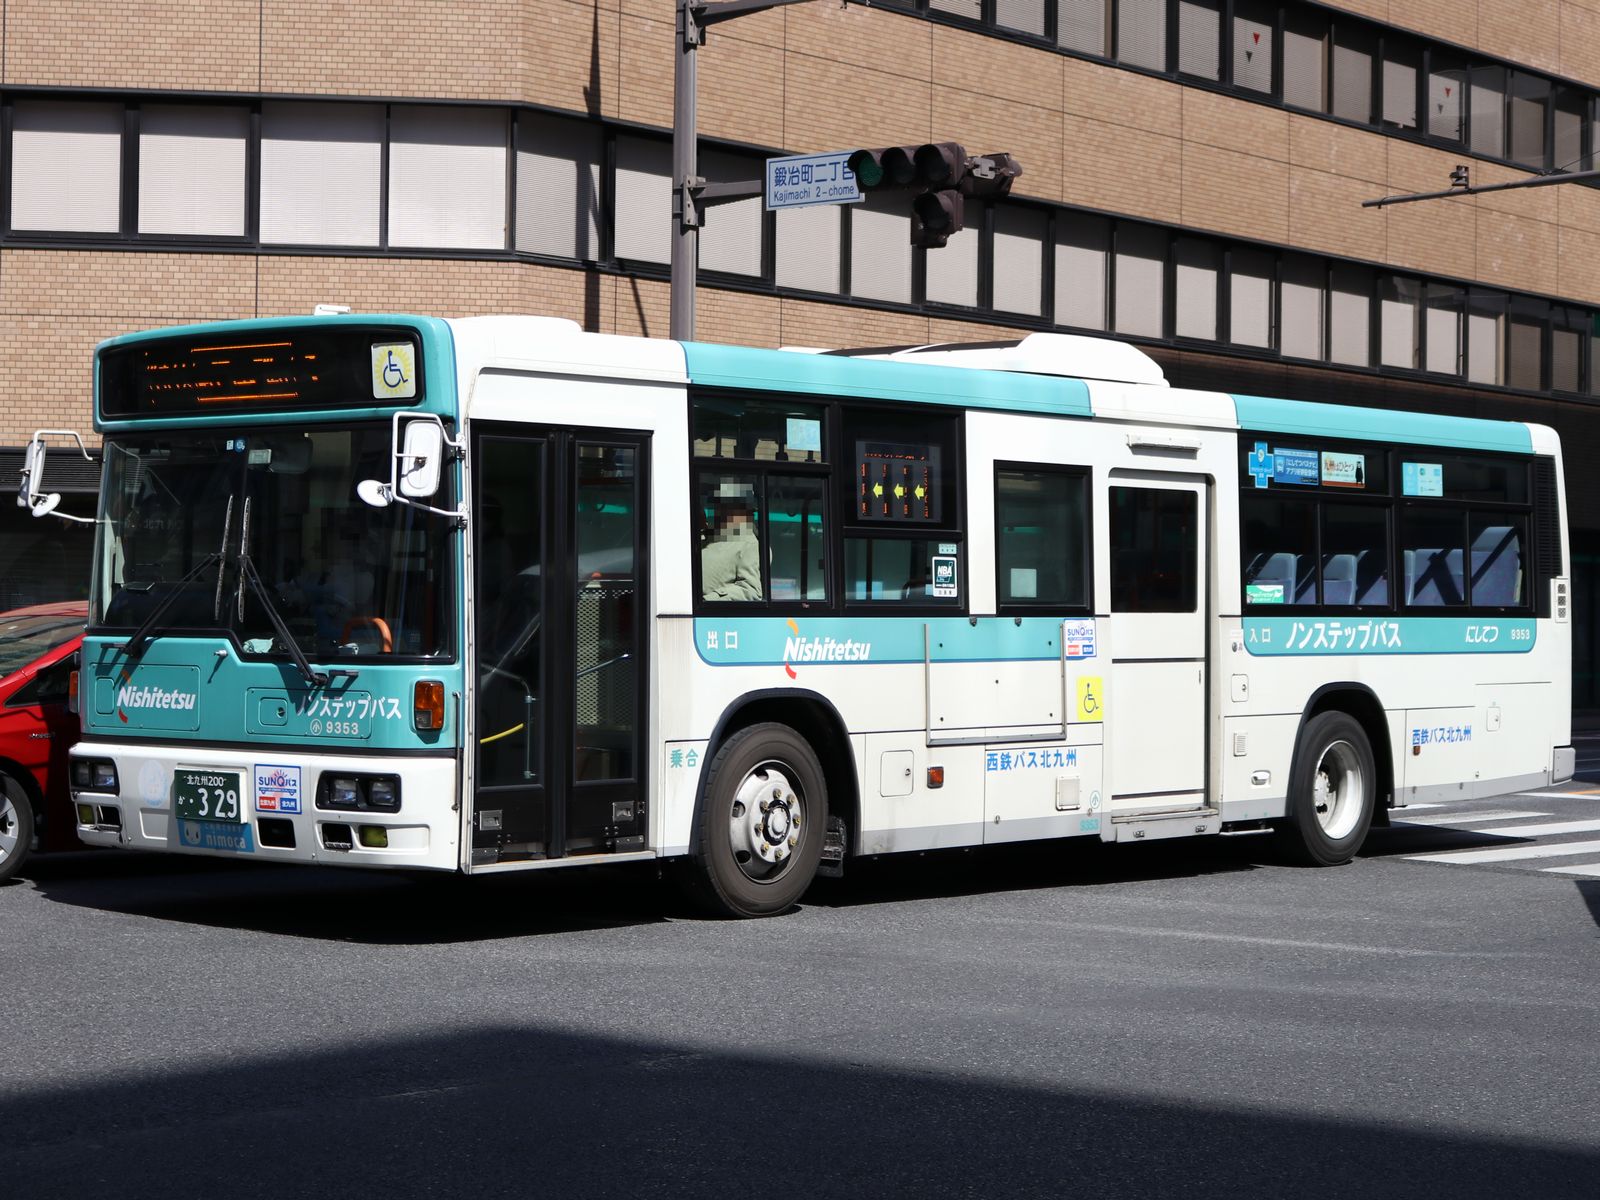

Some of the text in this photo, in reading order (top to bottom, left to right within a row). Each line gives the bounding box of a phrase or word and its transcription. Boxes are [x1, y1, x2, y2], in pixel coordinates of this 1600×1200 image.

[774, 160, 855, 187] 鍛冶町二丁目
[773, 187, 811, 203] Kajimachi
[706, 630, 738, 650] 出口
[1249, 628, 1271, 643] 入口
[1285, 620, 1402, 649] ノンステップバス
[1465, 625, 1499, 643] にしてつ
[783, 636, 871, 662] Nishitetsu
[117, 686, 196, 710] Nishitetsu
[297, 695, 402, 719] ノンステップバス
[326, 721, 358, 735] 9353
[1412, 725, 1472, 745] 西鉄バス北九州
[670, 748, 698, 768] 乗合
[987, 748, 1077, 772] 西鉄バス北九州
[205, 834, 247, 849] nimoca
